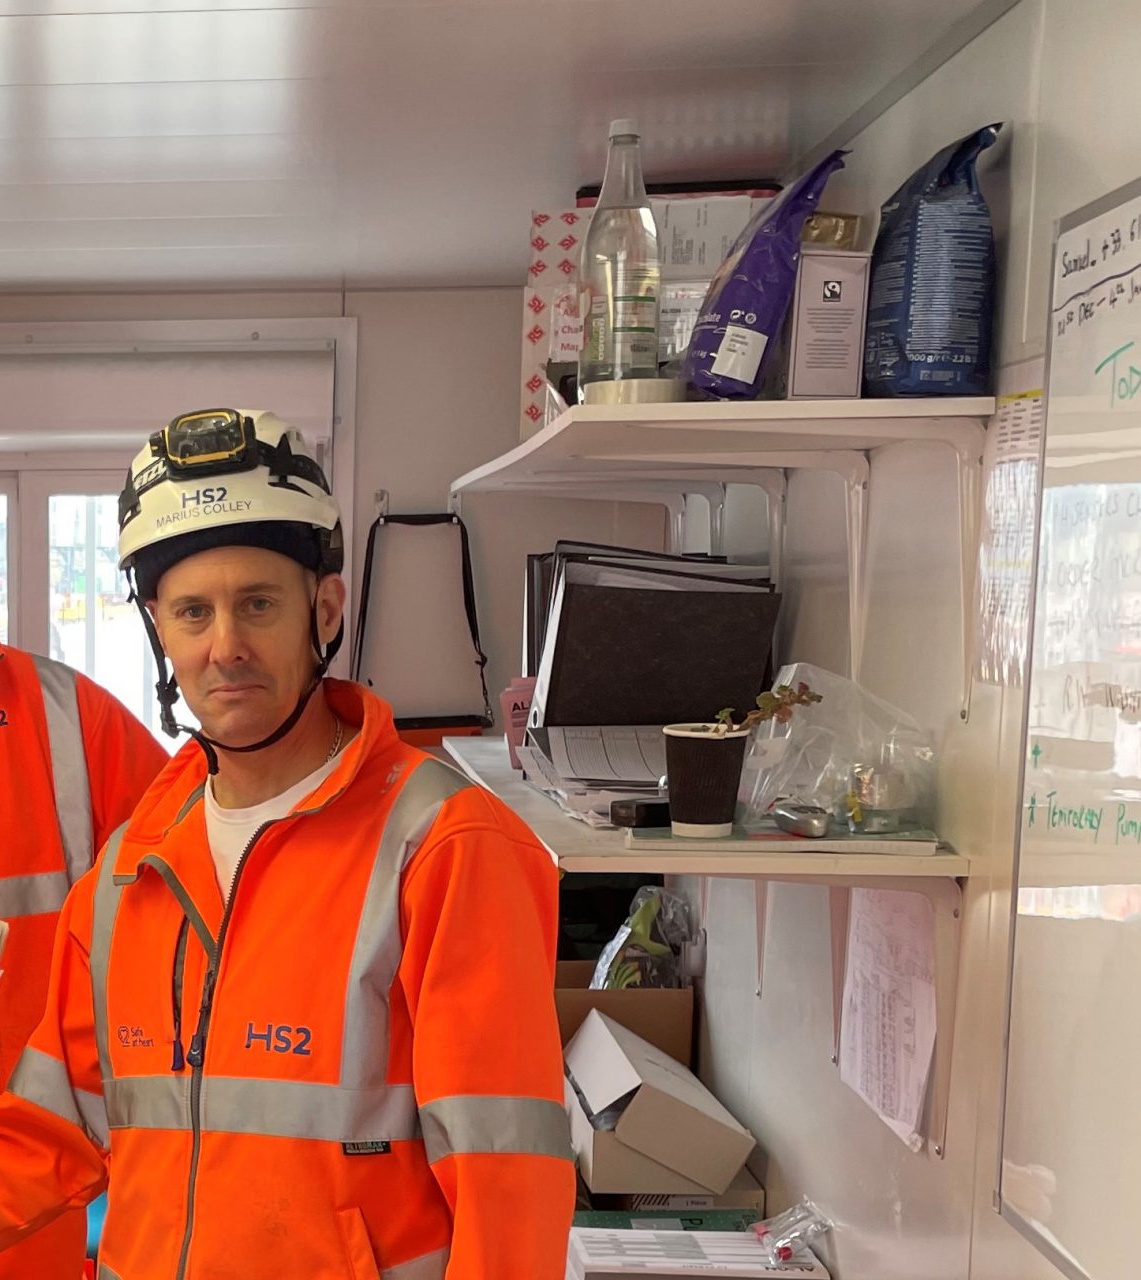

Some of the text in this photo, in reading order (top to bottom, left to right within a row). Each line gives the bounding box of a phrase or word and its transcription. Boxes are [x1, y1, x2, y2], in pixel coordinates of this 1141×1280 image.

[182, 487, 228, 508] HS2
[156, 500, 252, 528] MARIUS COLLEY
[512, 701, 530, 713] AL
[244, 1022, 312, 1055] HS2
